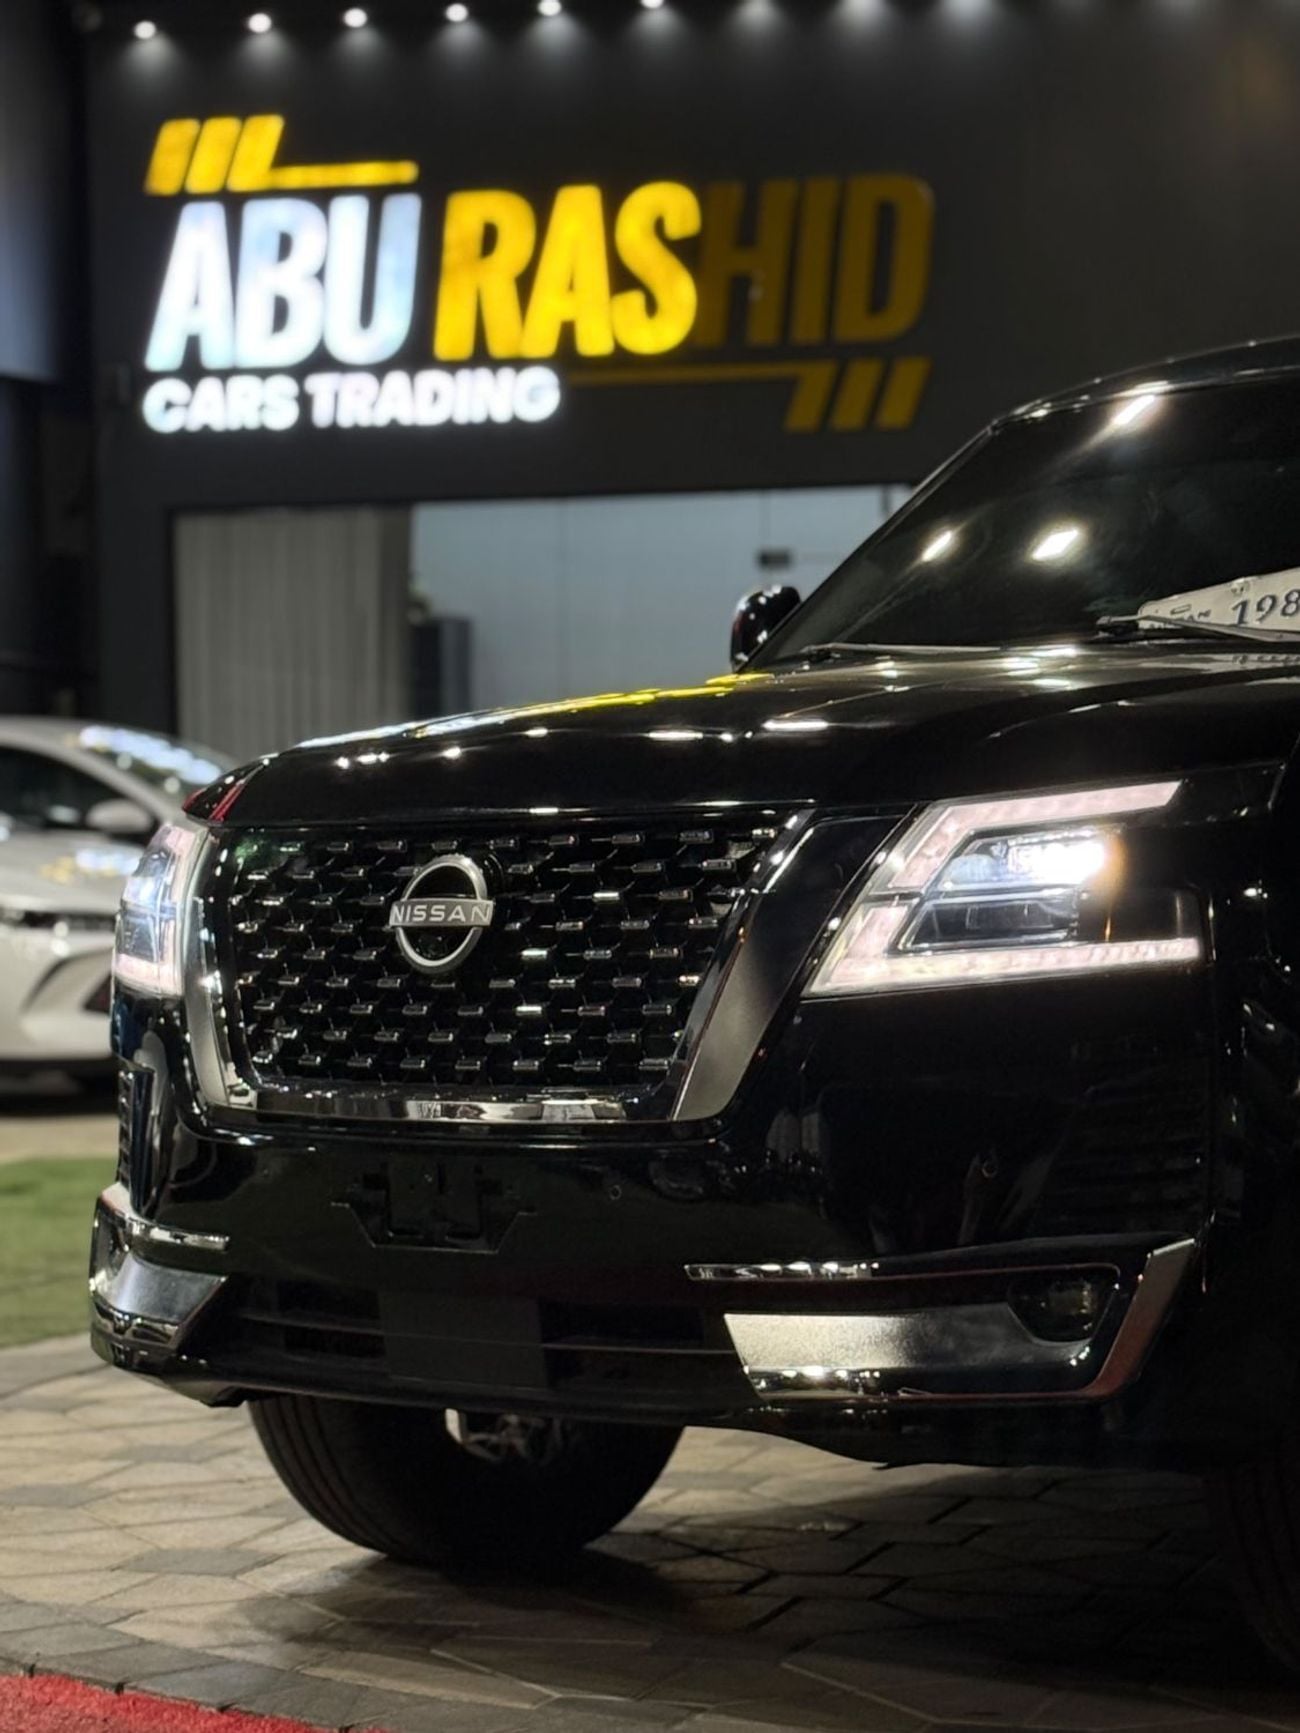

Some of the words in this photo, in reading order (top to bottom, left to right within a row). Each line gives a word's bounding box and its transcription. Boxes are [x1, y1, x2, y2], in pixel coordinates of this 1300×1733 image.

[146, 193, 422, 371] ABU
[433, 174, 936, 361] RASHID
[142, 374, 300, 433] CARS
[304, 366, 561, 428] TRADING
[391, 904, 492, 923] NISSAN
